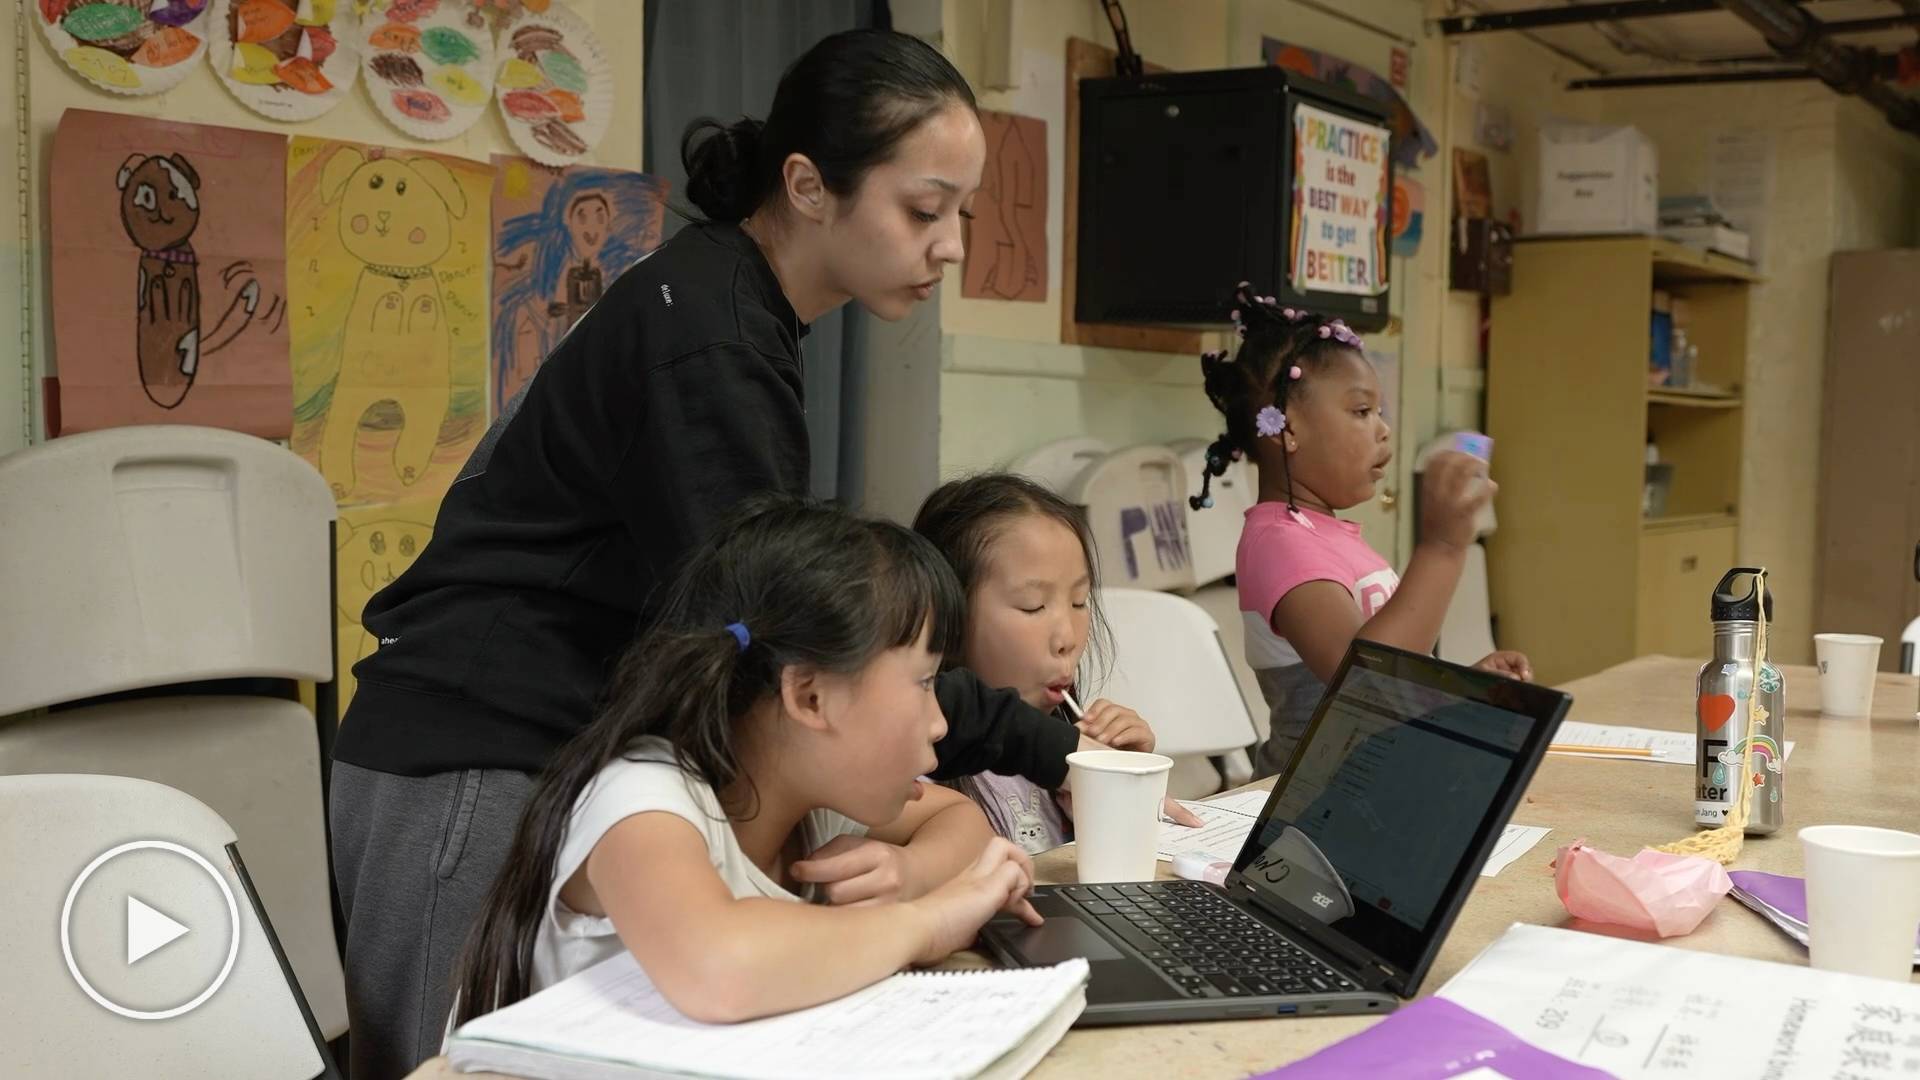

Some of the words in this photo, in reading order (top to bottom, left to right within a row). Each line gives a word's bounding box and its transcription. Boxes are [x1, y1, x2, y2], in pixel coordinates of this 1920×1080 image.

[1306, 117, 1378, 163] PRACTICE
[1326, 159, 1336, 182] is
[1338, 163, 1356, 187] the
[1309, 187, 1338, 214] BEST
[1340, 193, 1370, 220] WAY
[1321, 221, 1333, 241] to
[1336, 224, 1357, 248] get
[1306, 248, 1369, 287] BETTER
[1703, 739, 1728, 777] F
[1701, 808, 1718, 818] Jang
[1312, 891, 1334, 908] acer
